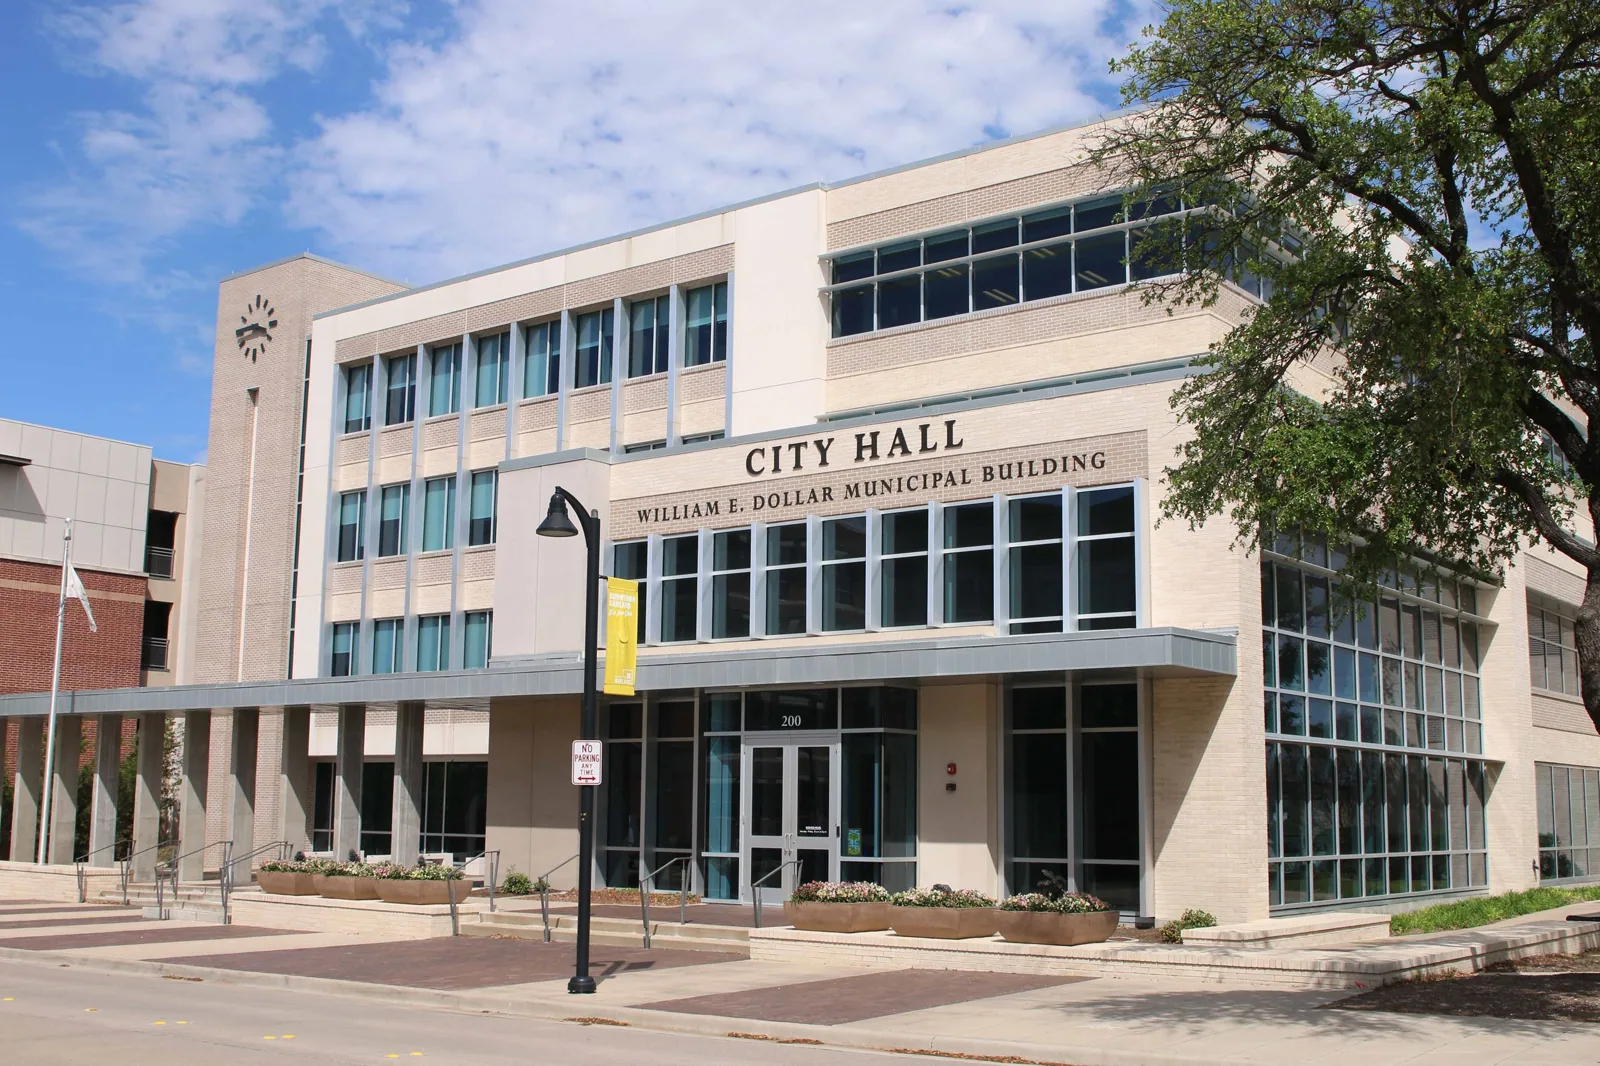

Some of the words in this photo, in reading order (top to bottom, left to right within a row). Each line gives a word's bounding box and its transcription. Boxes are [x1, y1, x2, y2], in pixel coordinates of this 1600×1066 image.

[745, 437, 836, 476] CITY
[853, 419, 965, 462] HALL
[637, 501, 720, 524] WILLIAM
[728, 498, 744, 514] E.
[752, 486, 834, 511] DOLLAR
[845, 468, 972, 499] MUNICIPAL
[982, 451, 1107, 483] BUILDING
[781, 715, 802, 727] 200
[581, 744, 593, 753] NO
[574, 754, 600, 763] PARKING
